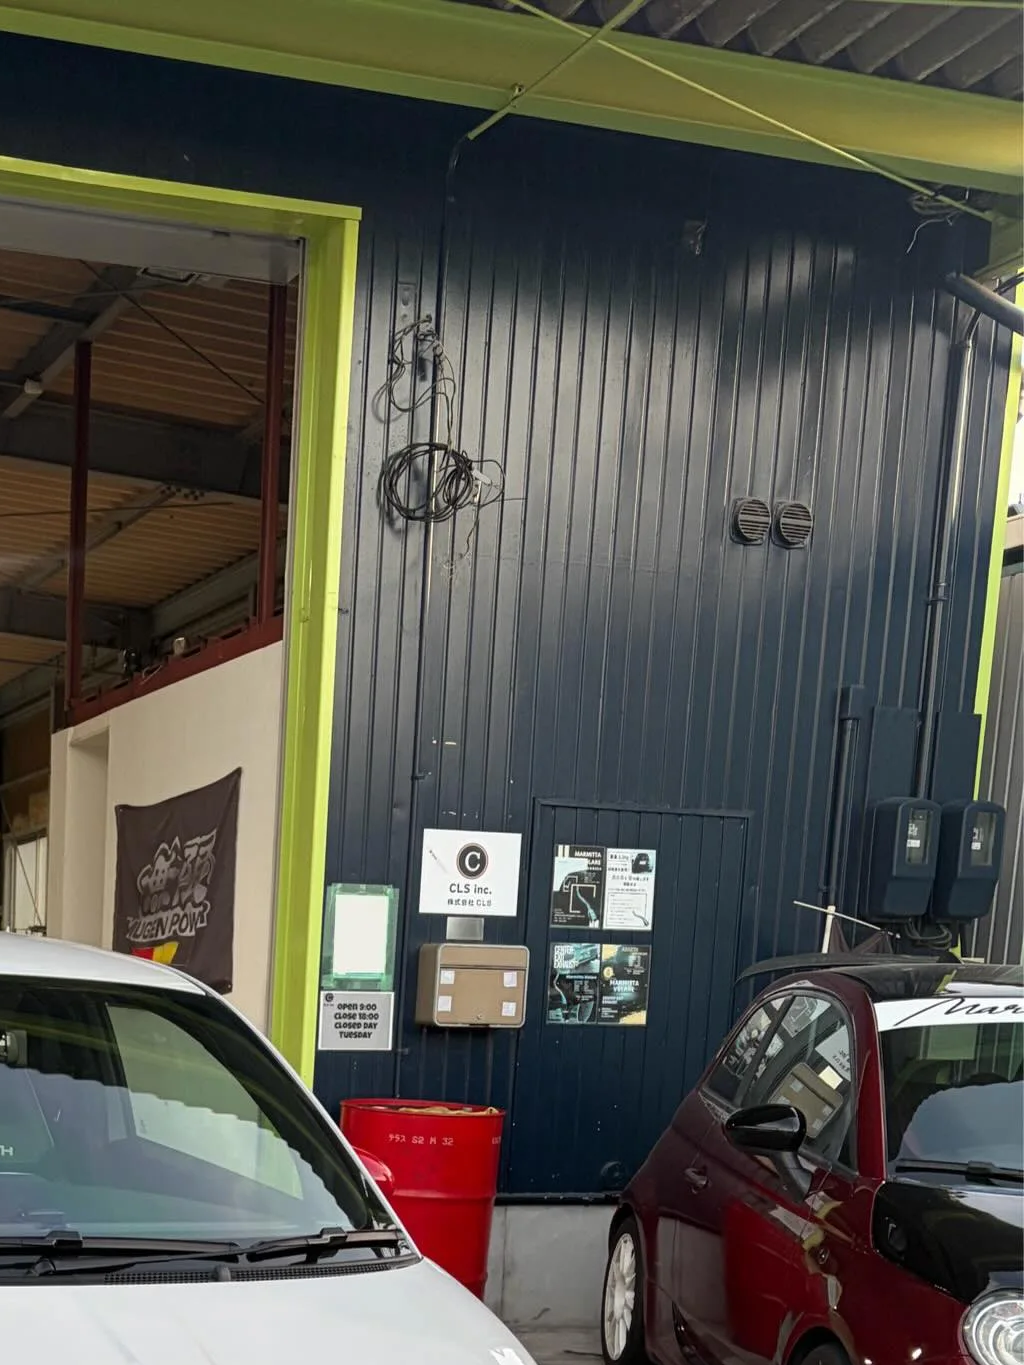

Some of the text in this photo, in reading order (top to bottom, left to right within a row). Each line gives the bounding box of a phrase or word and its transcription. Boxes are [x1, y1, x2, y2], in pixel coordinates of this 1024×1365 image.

[449, 883, 493, 896] CLS inc.
[359, 1003, 377, 1011] 9:00
[363, 1022, 378, 1030] DAY
[441, 1137, 454, 1146] 32
